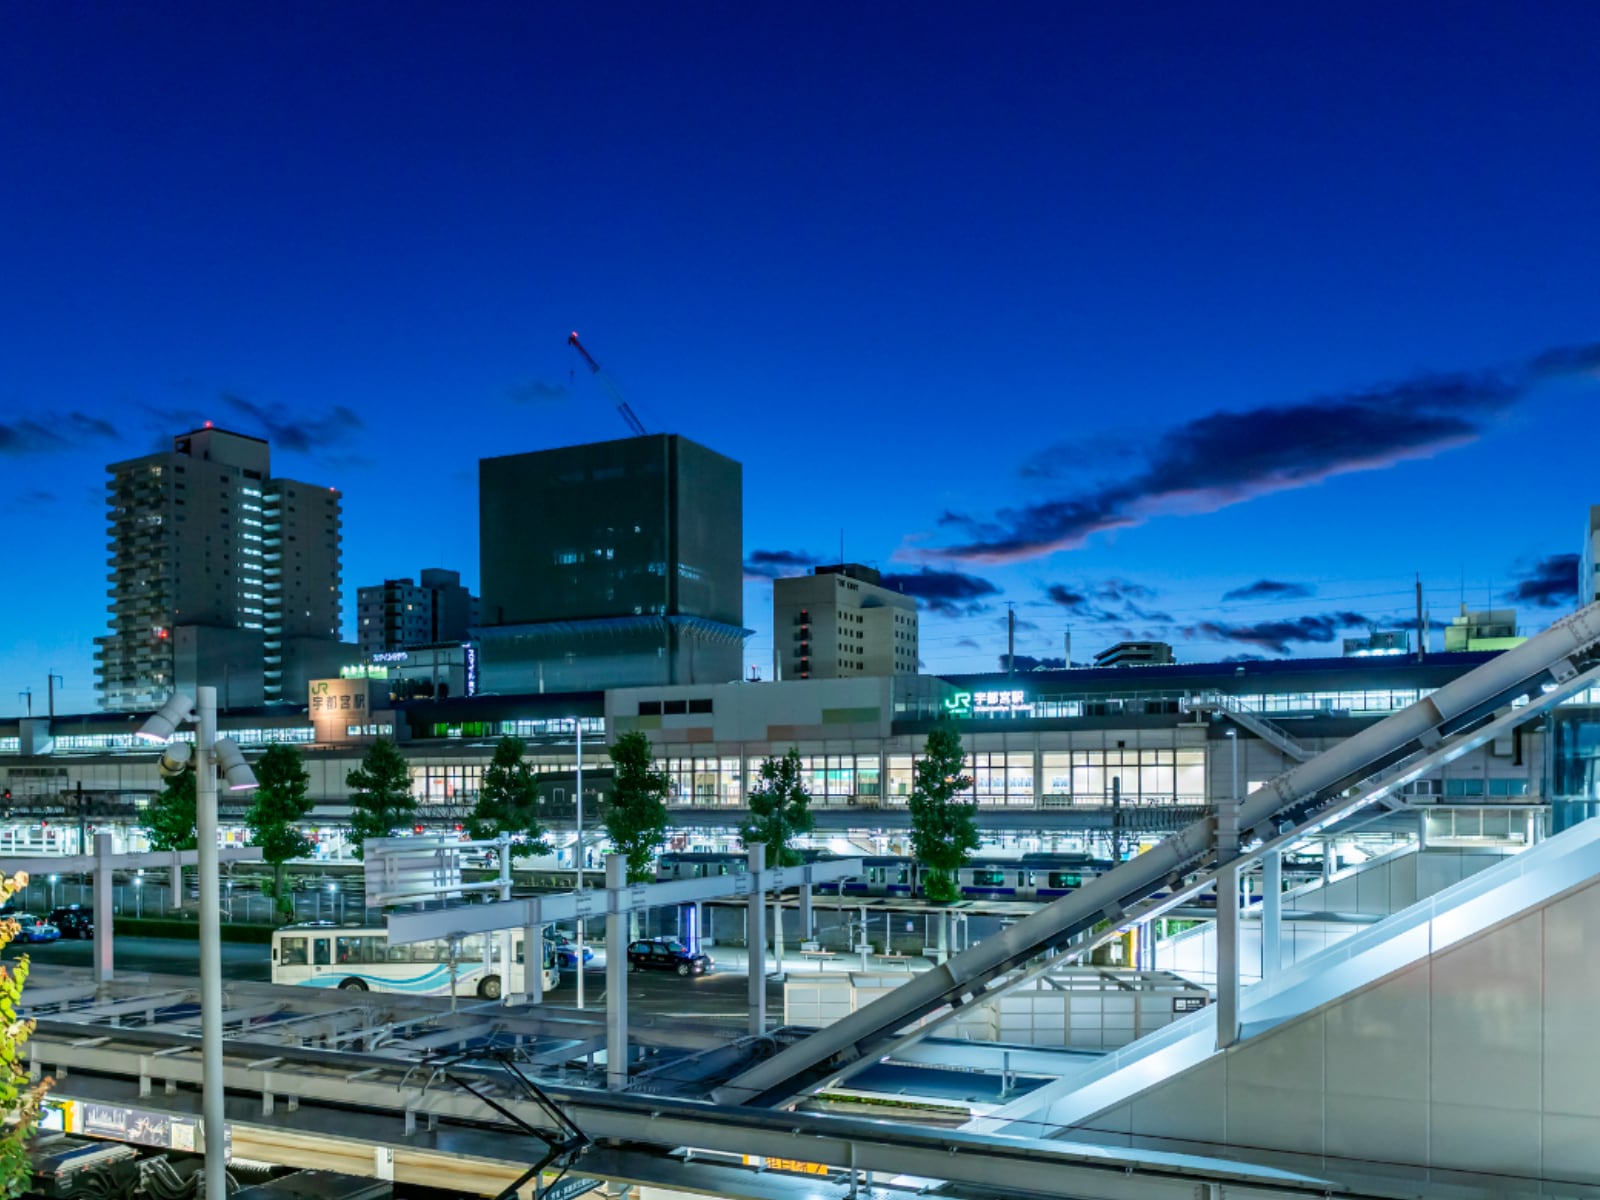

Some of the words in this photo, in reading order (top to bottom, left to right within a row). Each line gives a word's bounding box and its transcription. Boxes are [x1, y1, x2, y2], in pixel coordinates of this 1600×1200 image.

[311, 682, 328, 695] JR
[312, 694, 364, 710] 宇都宮駅
[945, 692, 971, 708] JR
[974, 691, 1024, 705] 宇都宮駅
